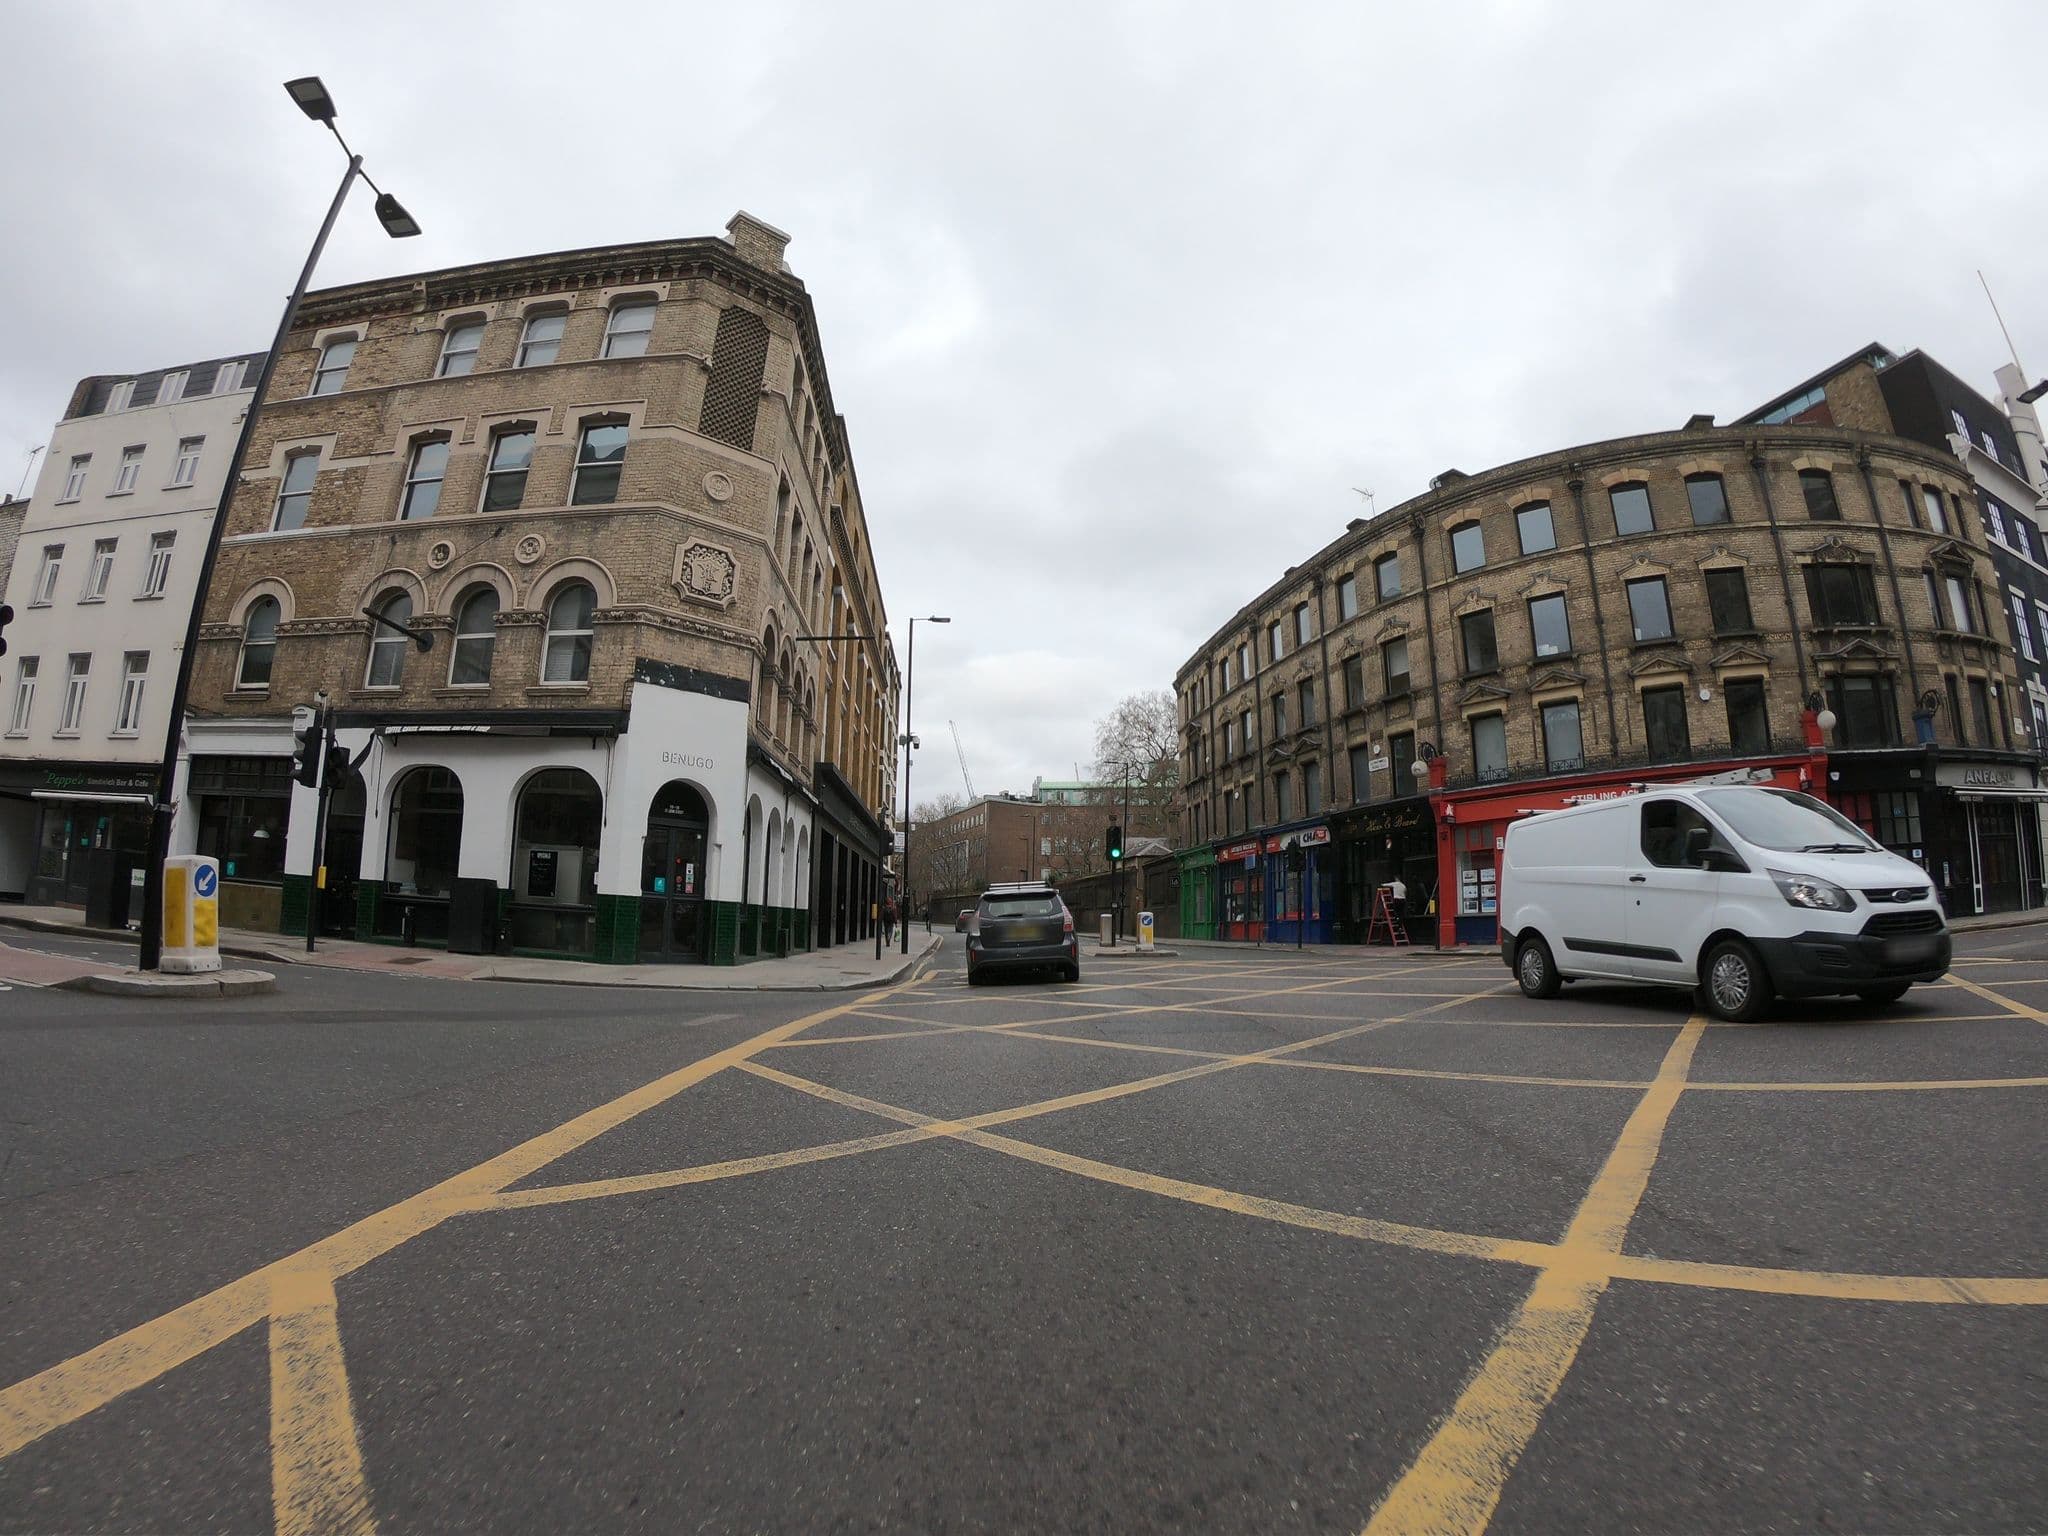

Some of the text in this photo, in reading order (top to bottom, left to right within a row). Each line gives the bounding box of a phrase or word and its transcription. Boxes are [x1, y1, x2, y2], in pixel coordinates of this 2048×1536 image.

[662, 751, 714, 769] BENUGO
[1965, 769, 1997, 784] ANFA
[1571, 791, 1617, 801] STIRLING
